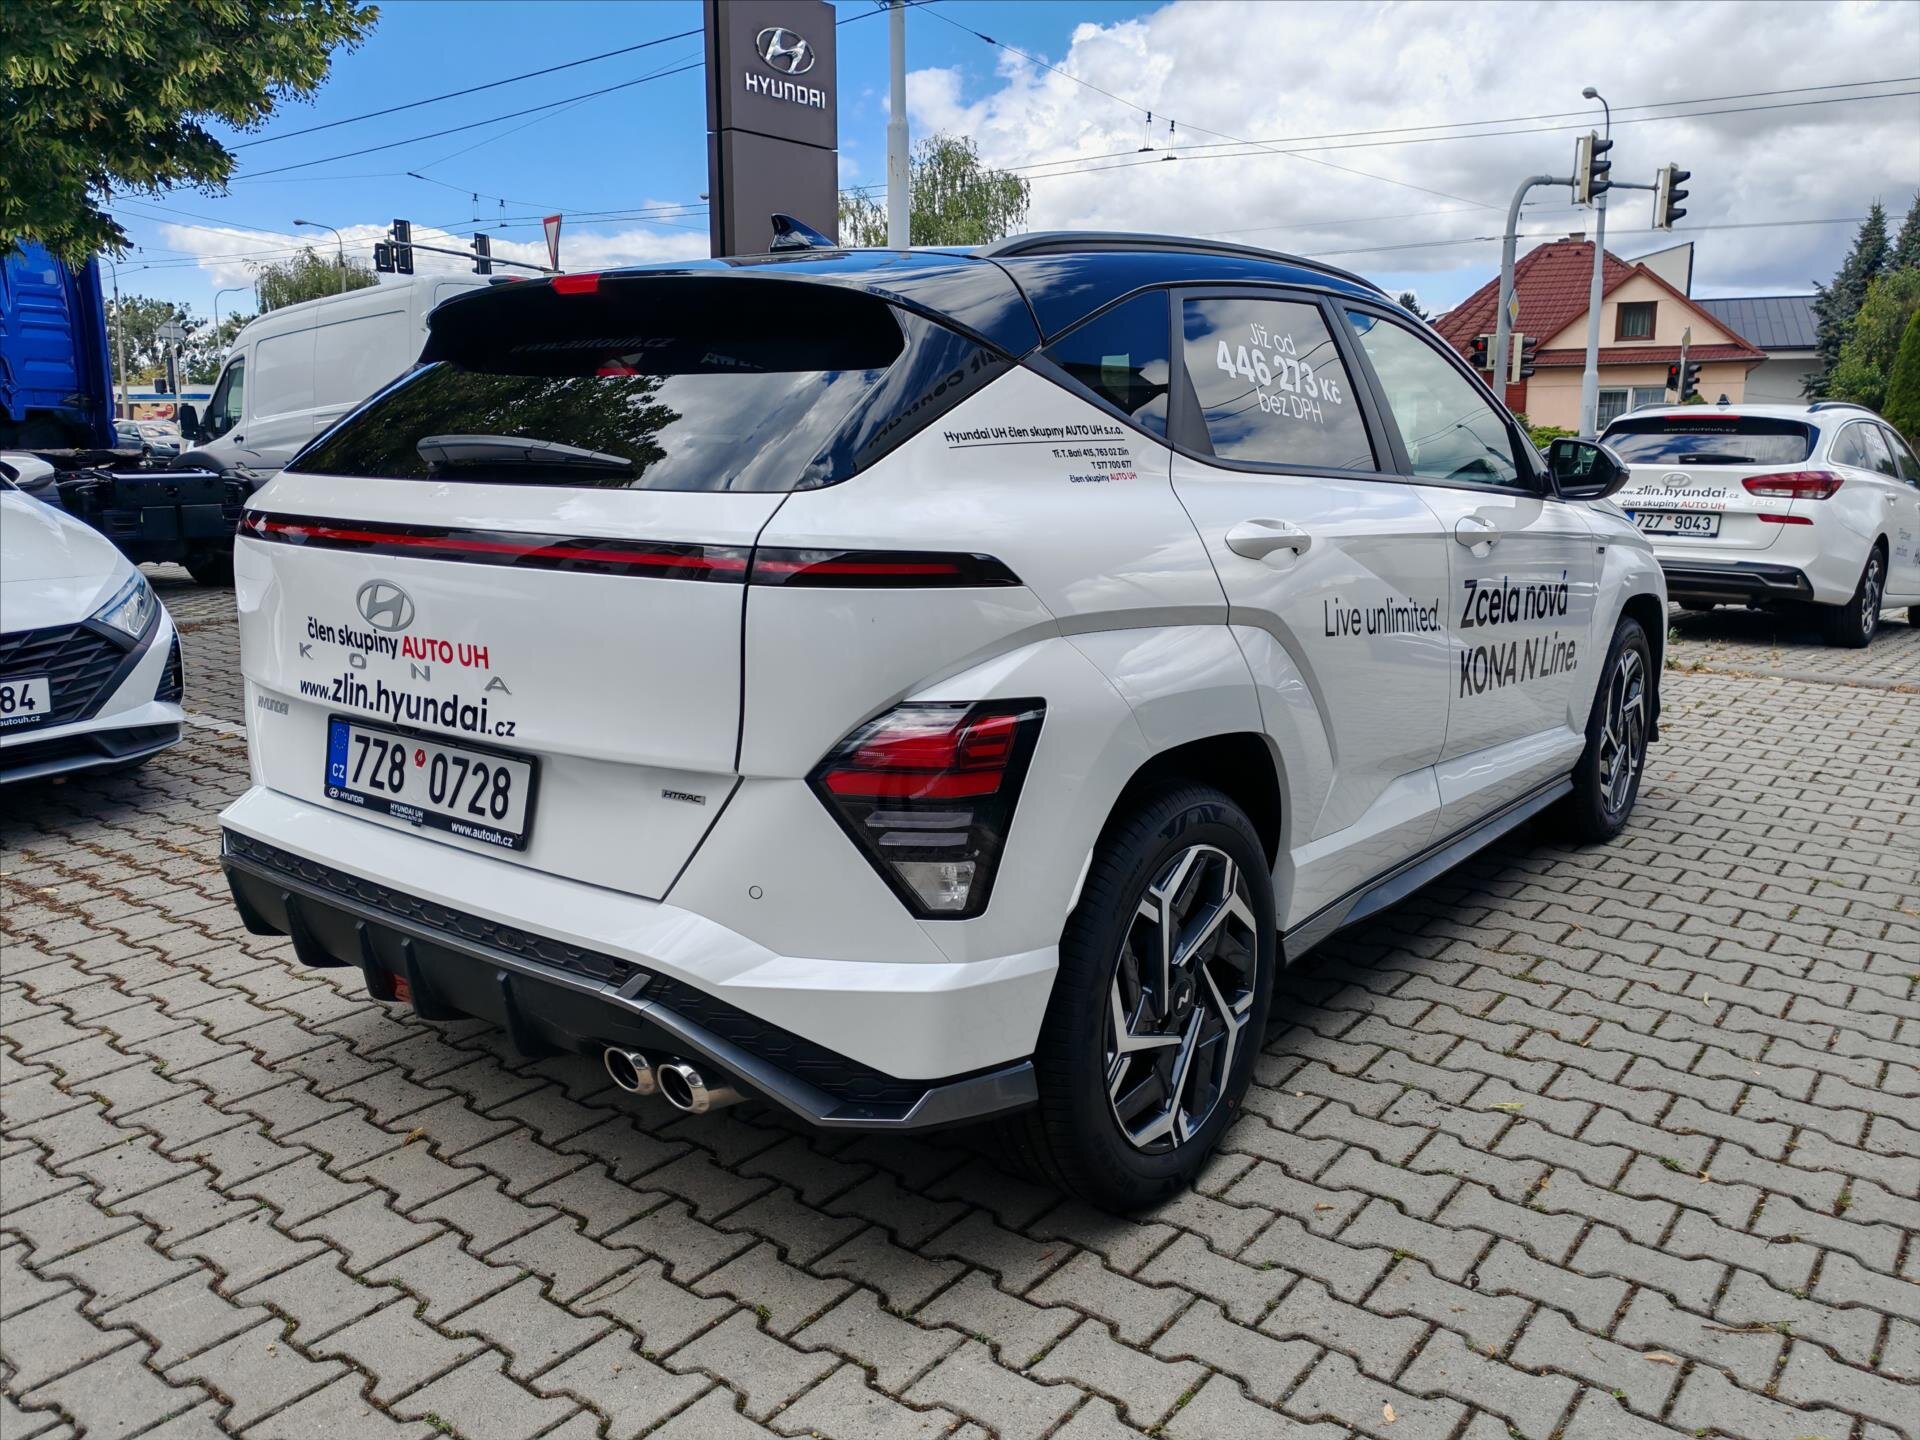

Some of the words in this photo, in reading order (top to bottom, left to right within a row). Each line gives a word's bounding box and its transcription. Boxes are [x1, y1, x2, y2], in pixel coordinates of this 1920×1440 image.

[745, 72, 826, 109] HYUNDAI
[1249, 322, 1272, 349] Již
[1273, 334, 1297, 356] od
[1216, 340, 1272, 386] 446
[1273, 354, 1318, 398] 273
[1319, 378, 1342, 405] Kč
[1255, 386, 1290, 417] bez
[1292, 395, 1324, 424] DPH
[944, 426, 991, 443] Hyundai
[992, 426, 1007, 439] UH
[1008, 424, 1029, 438] člen
[1030, 425, 1065, 439] skupiny
[1065, 424, 1089, 435] AUTO
[1089, 424, 1103, 435] UH
[1104, 427, 1124, 435] s.r.o.
[1085, 473, 1109, 483] skupiny
[1110, 471, 1127, 480] AUTO
[1128, 471, 1137, 480] UH
[1643, 500, 1679, 509] skupiny
[1680, 501, 1709, 509] AUTO
[1710, 503, 1726, 511] UH
[1637, 513, 1663, 529] 7Z7
[1674, 515, 1711, 531] 9043
[1460, 576, 1519, 629] Zcela
[1525, 570, 1569, 619] nová
[1323, 597, 1361, 637] Live
[1366, 598, 1441, 635] unlimited.
[307, 616, 336, 644] člen
[338, 624, 398, 660] skupiny
[402, 635, 454, 664] AUTO
[457, 644, 490, 669] UH
[299, 642, 513, 695] KONA
[1460, 641, 1516, 699] KONA
[1520, 636, 1540, 683] N
[1540, 631, 1577, 679] Line.
[0, 683, 36, 713] 84
[332, 763, 345, 779] CZ
[352, 734, 407, 794] 7Z8
[429, 752, 512, 820] 0728
[340, 791, 365, 805] HYUNDAI
[390, 802, 415, 815] HYUNDAI
[663, 790, 702, 803] HTRAC
[451, 821, 513, 848] www.autouh.cz
